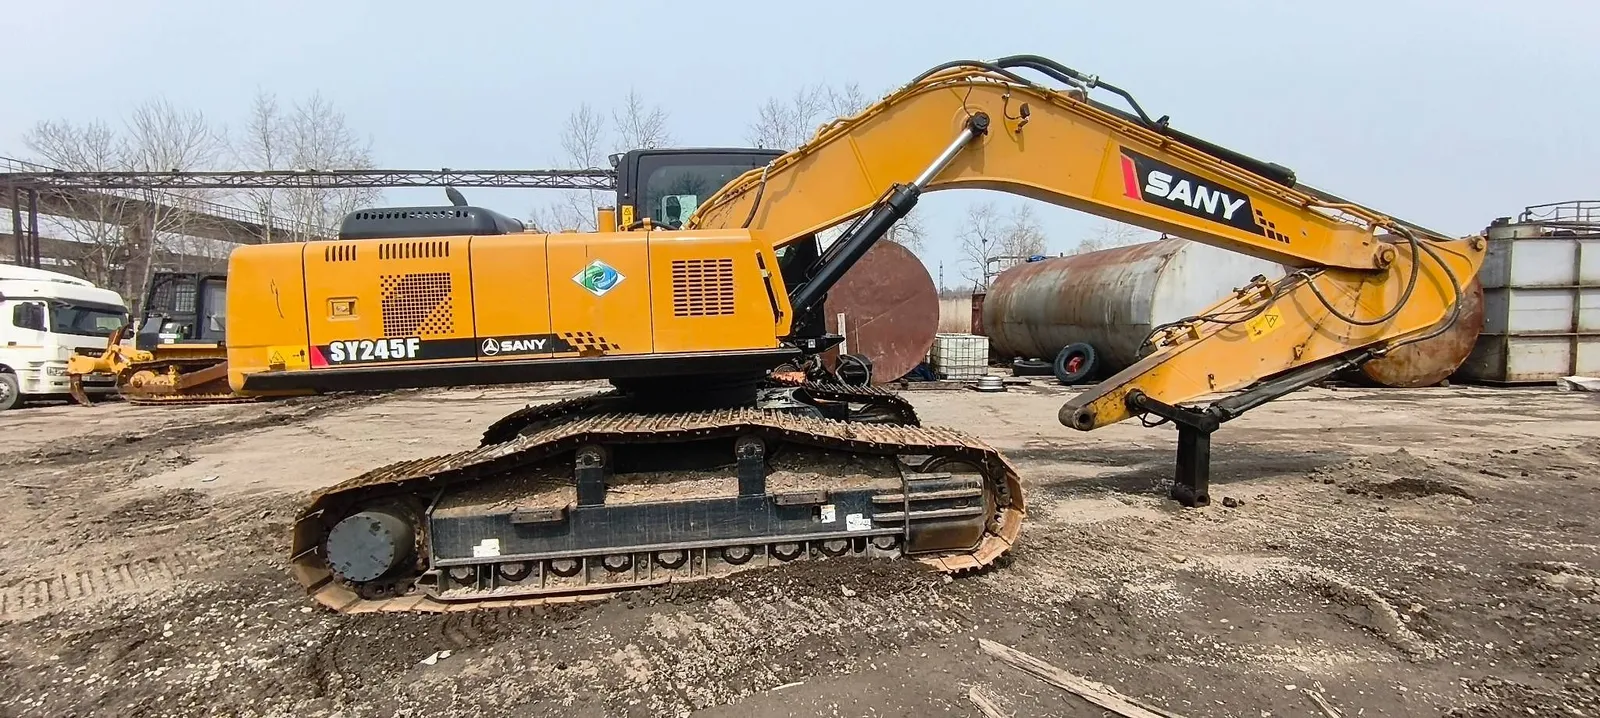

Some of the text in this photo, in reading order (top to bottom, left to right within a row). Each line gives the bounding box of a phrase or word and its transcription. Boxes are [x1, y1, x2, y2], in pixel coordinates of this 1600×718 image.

[1145, 170, 1246, 220] SANY
[330, 338, 420, 362] SY245F
[501, 339, 547, 352] SANY
